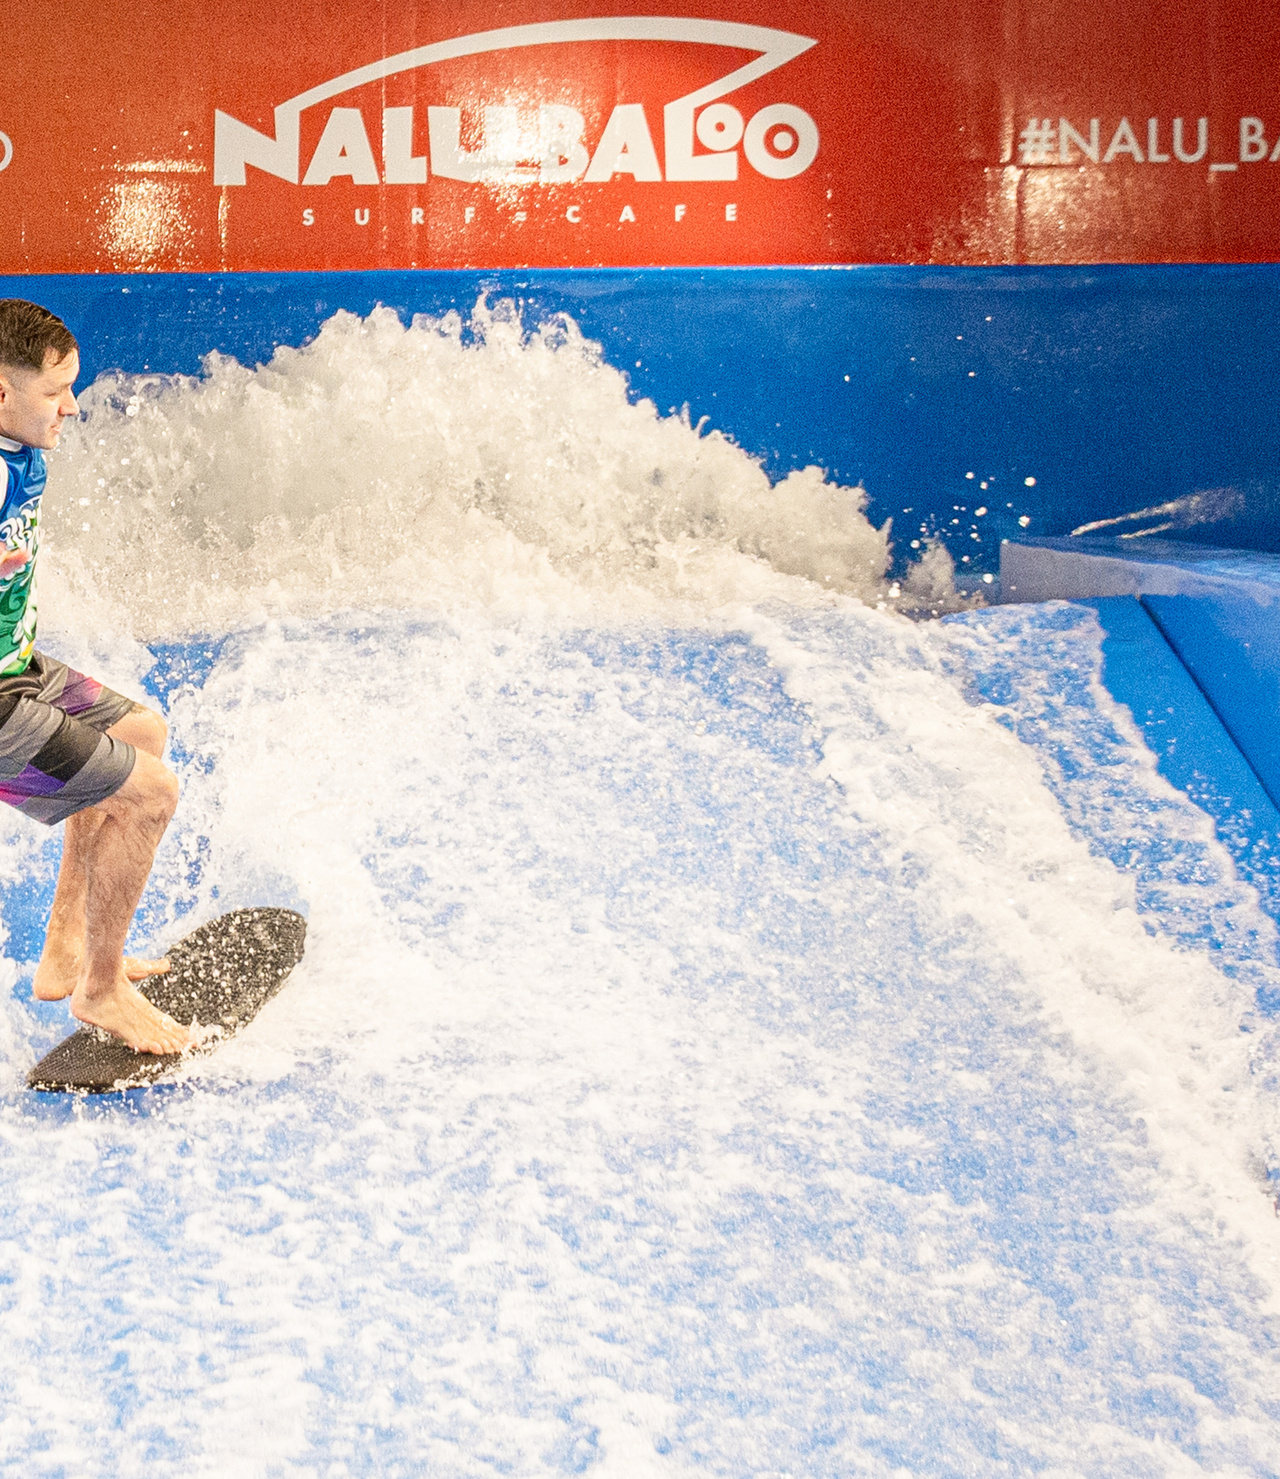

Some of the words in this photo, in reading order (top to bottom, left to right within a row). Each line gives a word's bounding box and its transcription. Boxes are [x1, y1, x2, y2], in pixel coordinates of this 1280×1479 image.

[1019, 115, 1280, 173] #NALU_B
[302, 207, 476, 227] SURF
[566, 203, 738, 224] CAFE
